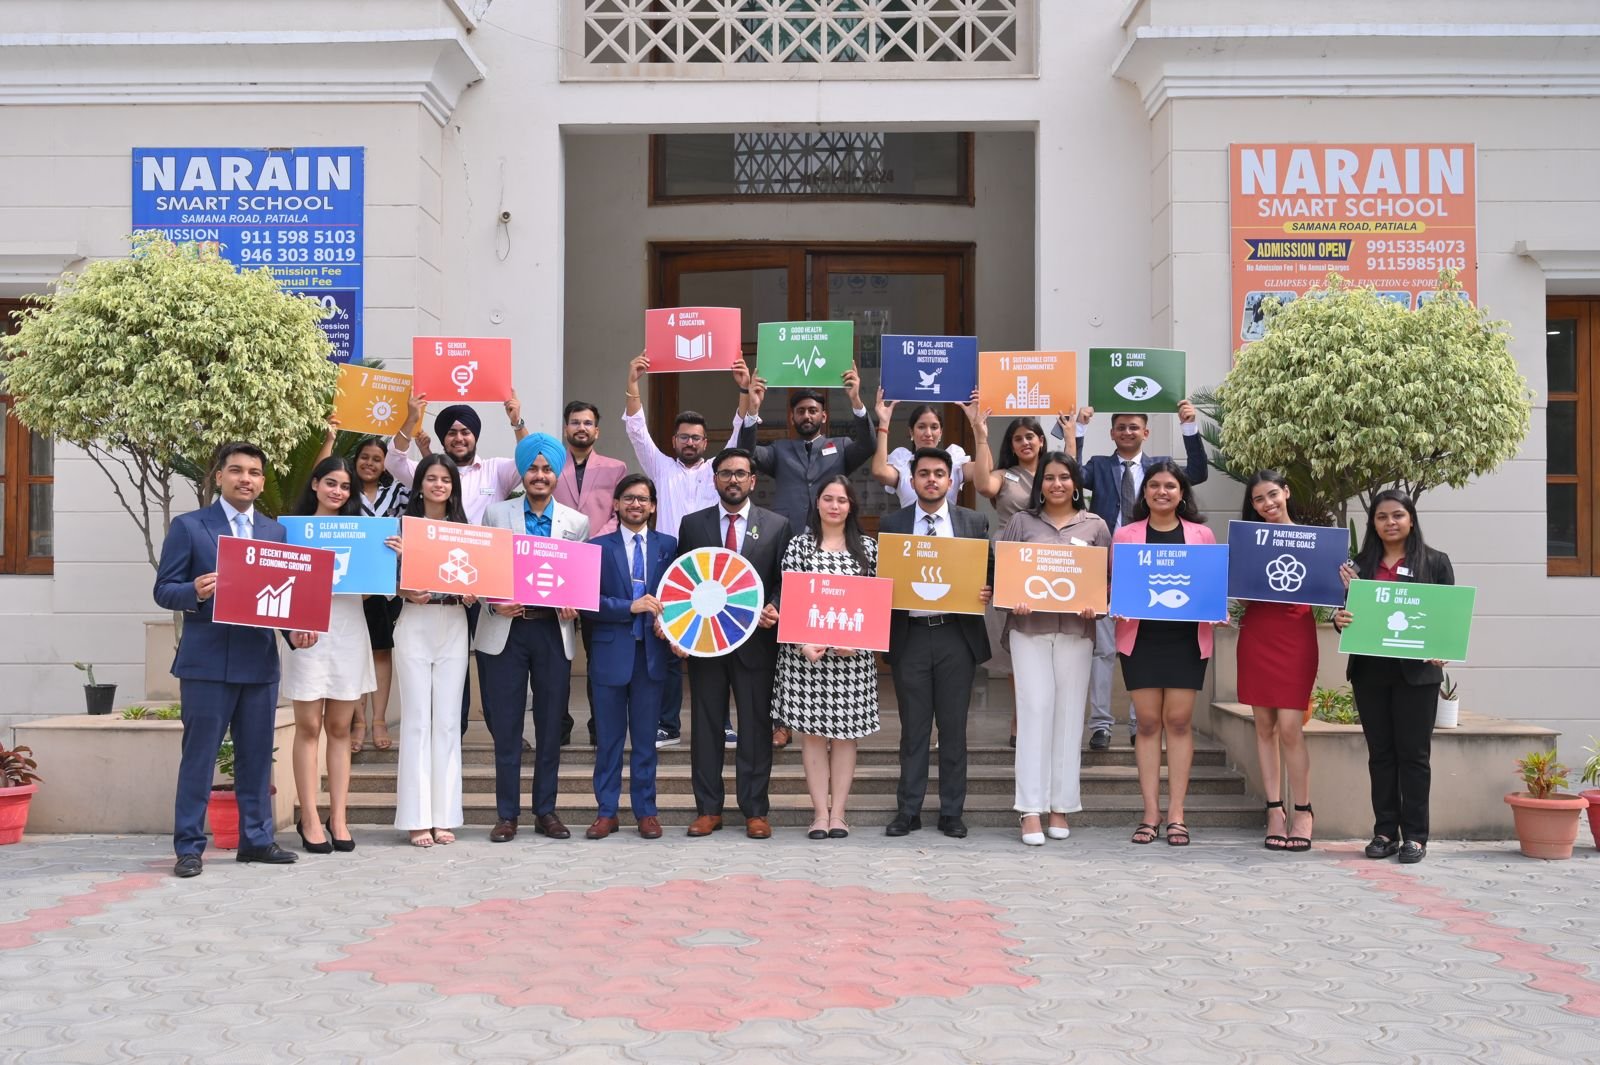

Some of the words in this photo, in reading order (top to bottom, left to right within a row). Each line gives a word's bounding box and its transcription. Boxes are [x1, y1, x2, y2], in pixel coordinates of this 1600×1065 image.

[142, 156, 351, 191] NARAIN
[1240, 149, 1464, 195] NARAIN
[156, 196, 231, 211] SMART
[238, 196, 334, 210] SCHOOL
[1258, 198, 1338, 217] SMART
[1345, 198, 1448, 217] SCHOOL
[181, 214, 228, 224] SAMANA
[229, 214, 262, 225] ROAD,
[265, 214, 309, 223] PATIALA
[1292, 222, 1337, 231] SAMANA
[1339, 222, 1372, 232] ROAD,
[1375, 222, 1417, 231] PATIALA
[143, 228, 219, 241] MISSION
[240, 230, 272, 244] 911
[277, 230, 308, 244] 598
[314, 230, 356, 243] 5103
[1257, 242, 1316, 258] ADMISSION
[1318, 242, 1346, 258] OPEN
[1366, 240, 1465, 254] 9915354073
[240, 248, 272, 262] 946
[277, 248, 308, 262] 303
[314, 248, 356, 261] 8019
[1255, 263, 1283, 272] Admission
[1283, 263, 1294, 272] Fee
[1308, 263, 1327, 272] Annual
[1366, 257, 1466, 271] 9115985103
[260, 266, 318, 276] dmission
[321, 267, 342, 276] Fee
[312, 277, 333, 286] Fee
[1264, 279, 1308, 288] GLIMPSES
[1357, 279, 1400, 288] FUNCTION
[1411, 279, 1441, 288] SPORT
[667, 313, 675, 327] 4
[679, 312, 699, 320] QUALITY
[679, 319, 705, 327] EDUCATION
[779, 328, 786, 341] 3
[804, 326, 823, 334] HEALTH
[800, 333, 828, 341] WELL-BEING
[435, 342, 443, 357] 5
[901, 340, 915, 356] 16
[934, 341, 954, 349] JUSTICE
[447, 349, 471, 357] EQUALITY
[917, 356, 949, 364] INSTITUTIONS
[999, 356, 1010, 371] 11
[1109, 352, 1122, 367] 13
[360, 372, 369, 387] 7
[371, 382, 387, 391] CLEAN
[304, 522, 314, 539] 6
[319, 522, 338, 530] CLEAN
[339, 522, 359, 530] WATER
[319, 531, 332, 539] AND
[332, 531, 366, 539] SANITATION
[426, 524, 436, 540] 9
[1255, 528, 1269, 546] 17
[1273, 530, 1317, 540] PARTNERSHIPS
[515, 540, 531, 556] 10
[533, 541, 559, 551] REDUCED
[903, 540, 911, 557] 2
[917, 541, 931, 549] ZERO
[1272, 539, 1284, 547] FOR
[1285, 539, 1296, 548] THE
[1296, 540, 1316, 549] GOALS
[245, 546, 256, 565] 8
[260, 548, 282, 558] DECENT
[282, 550, 299, 560] WORK
[299, 553, 312, 562] AND
[533, 549, 568, 560] INEQUALITIES
[916, 550, 939, 559] HUNGER
[1019, 547, 1033, 563] 12
[1036, 549, 1073, 558] RESPONSIBLE
[1137, 549, 1152, 566] 14
[1156, 550, 1168, 558] LIFE
[1168, 550, 1187, 558] BELOW
[259, 557, 288, 569] ECONOMIC
[288, 560, 312, 572] GROWTH
[1036, 556, 1076, 566] CONSUMPTION
[1156, 558, 1175, 567] WATER
[1036, 564, 1048, 572] AND
[1048, 564, 1083, 574] PRODUCTION
[809, 578, 815, 594] 1
[821, 579, 831, 587] NO
[821, 587, 846, 597] POVERTY
[1375, 586, 1391, 604] 15
[1395, 588, 1408, 596] LIFE
[1394, 596, 1404, 605] ON
[1403, 597, 1420, 606] LAND
